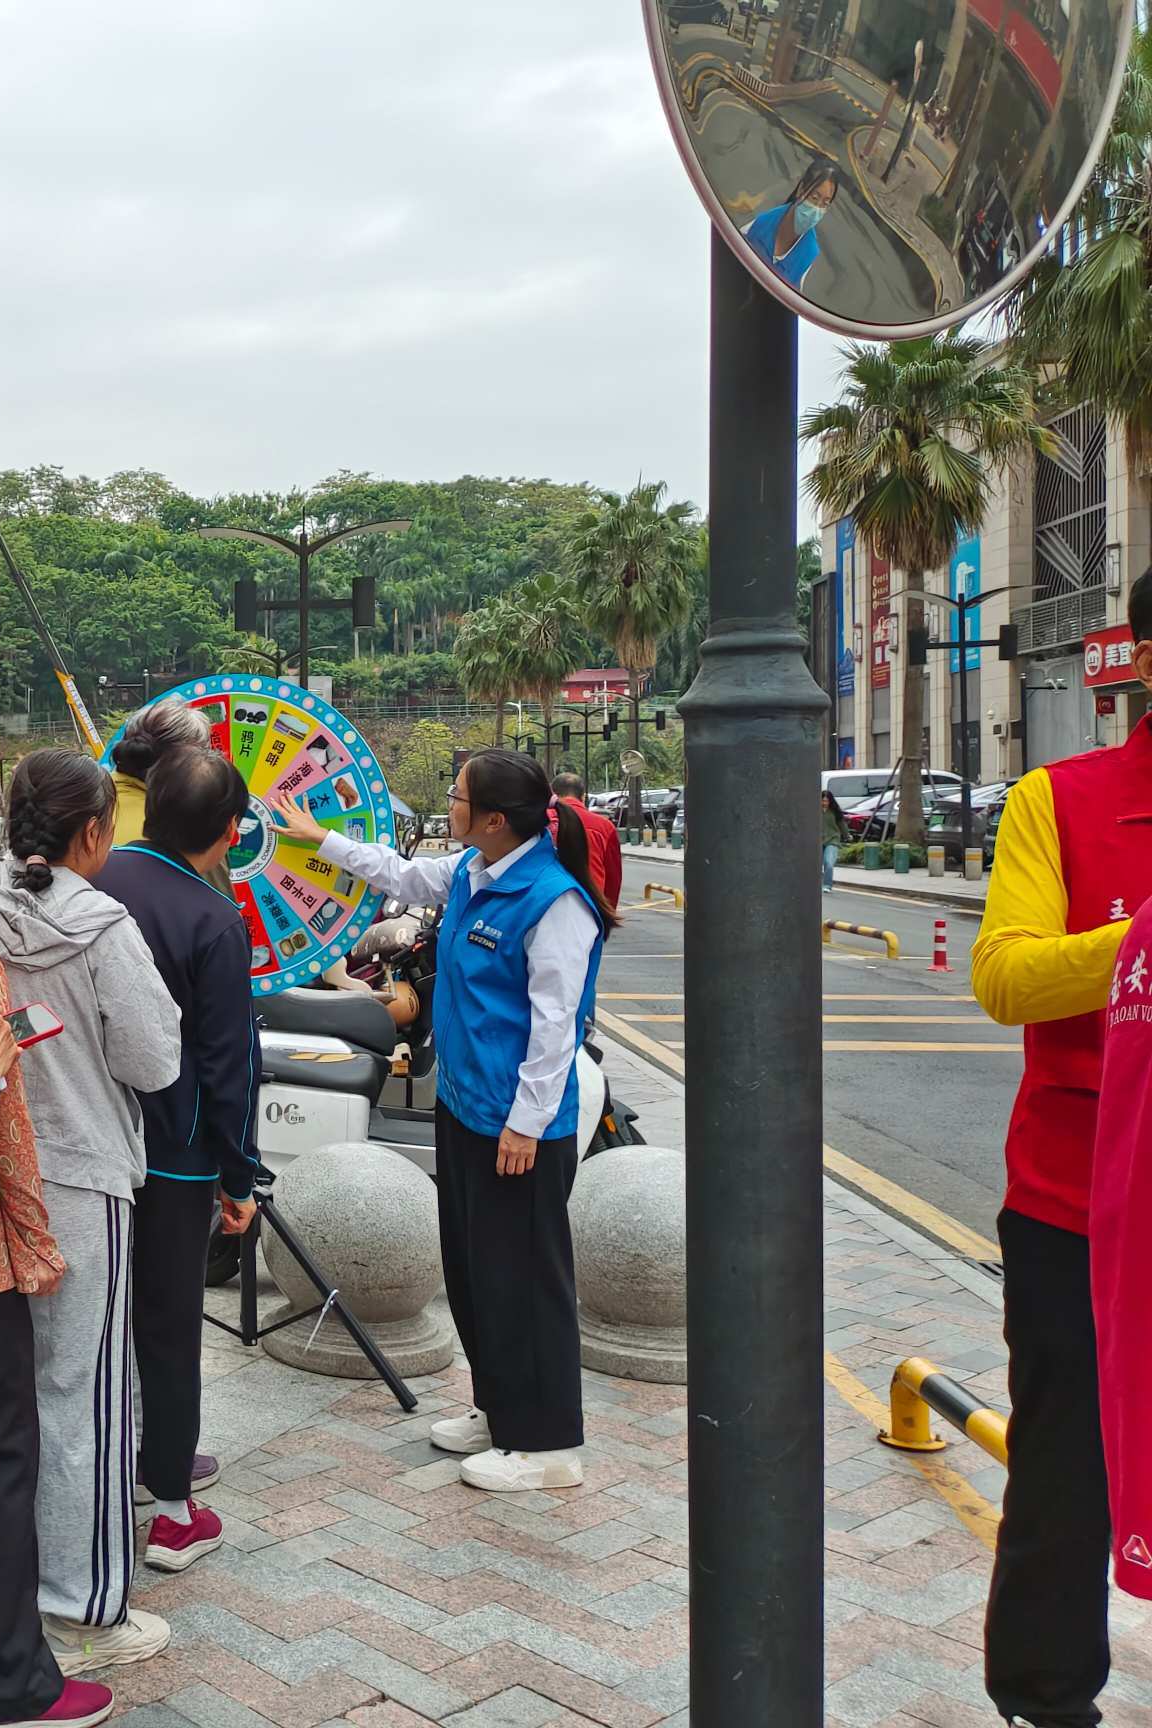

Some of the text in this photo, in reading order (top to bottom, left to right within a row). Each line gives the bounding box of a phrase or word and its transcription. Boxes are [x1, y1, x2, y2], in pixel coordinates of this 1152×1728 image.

[239, 730, 254, 757] 鸦片
[265, 740, 286, 767] 吗啡
[278, 762, 314, 792] 海洛因
[306, 857, 333, 877] 古柯
[280, 874, 318, 909] 可卡因
